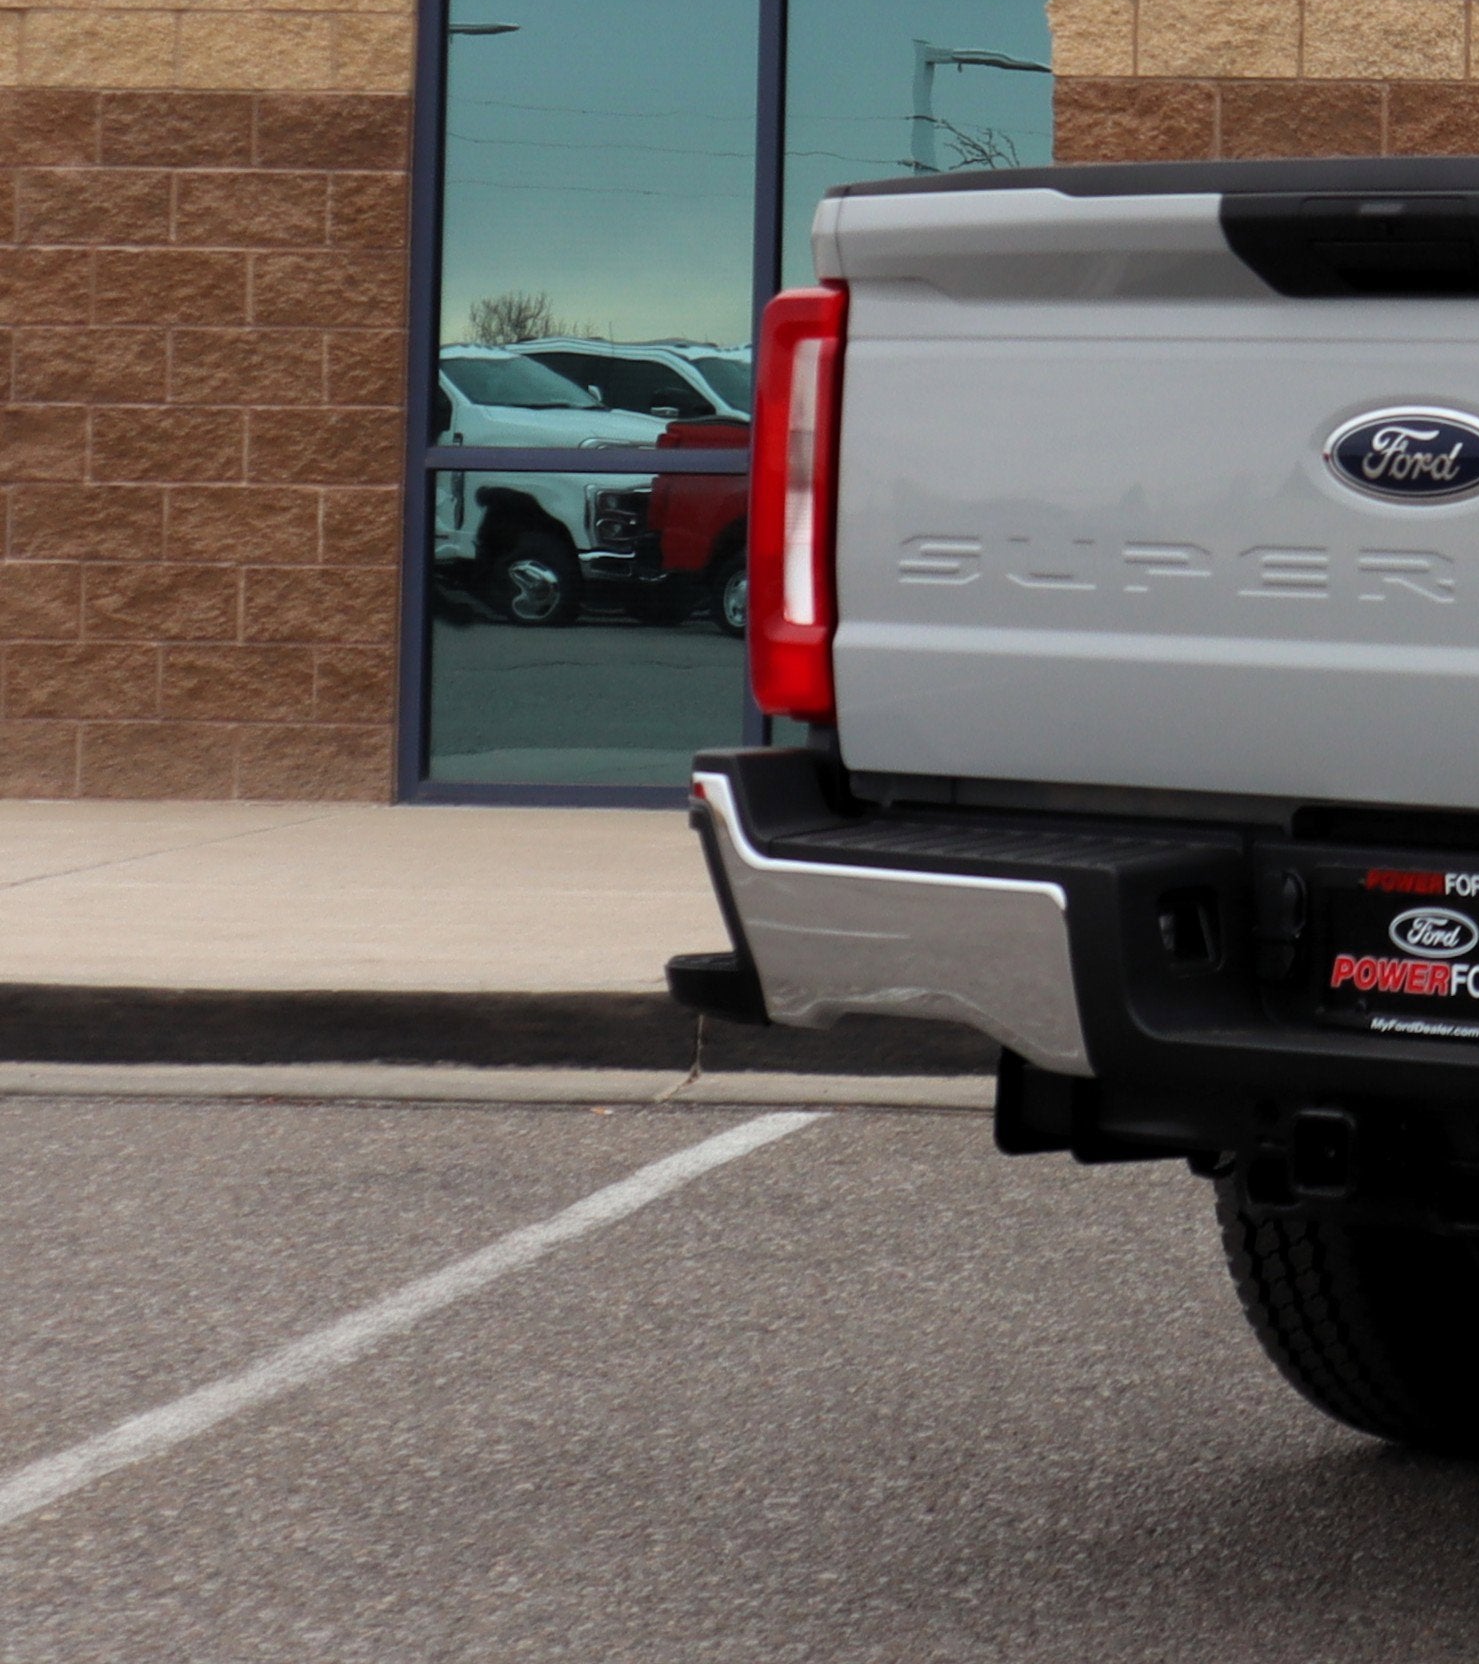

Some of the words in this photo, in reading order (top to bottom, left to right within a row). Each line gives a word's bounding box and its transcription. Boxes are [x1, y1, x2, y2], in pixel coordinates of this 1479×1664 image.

[1361, 425, 1462, 483] Ford
[897, 535, 1456, 604] SUPER
[1406, 917, 1462, 948] Ford
